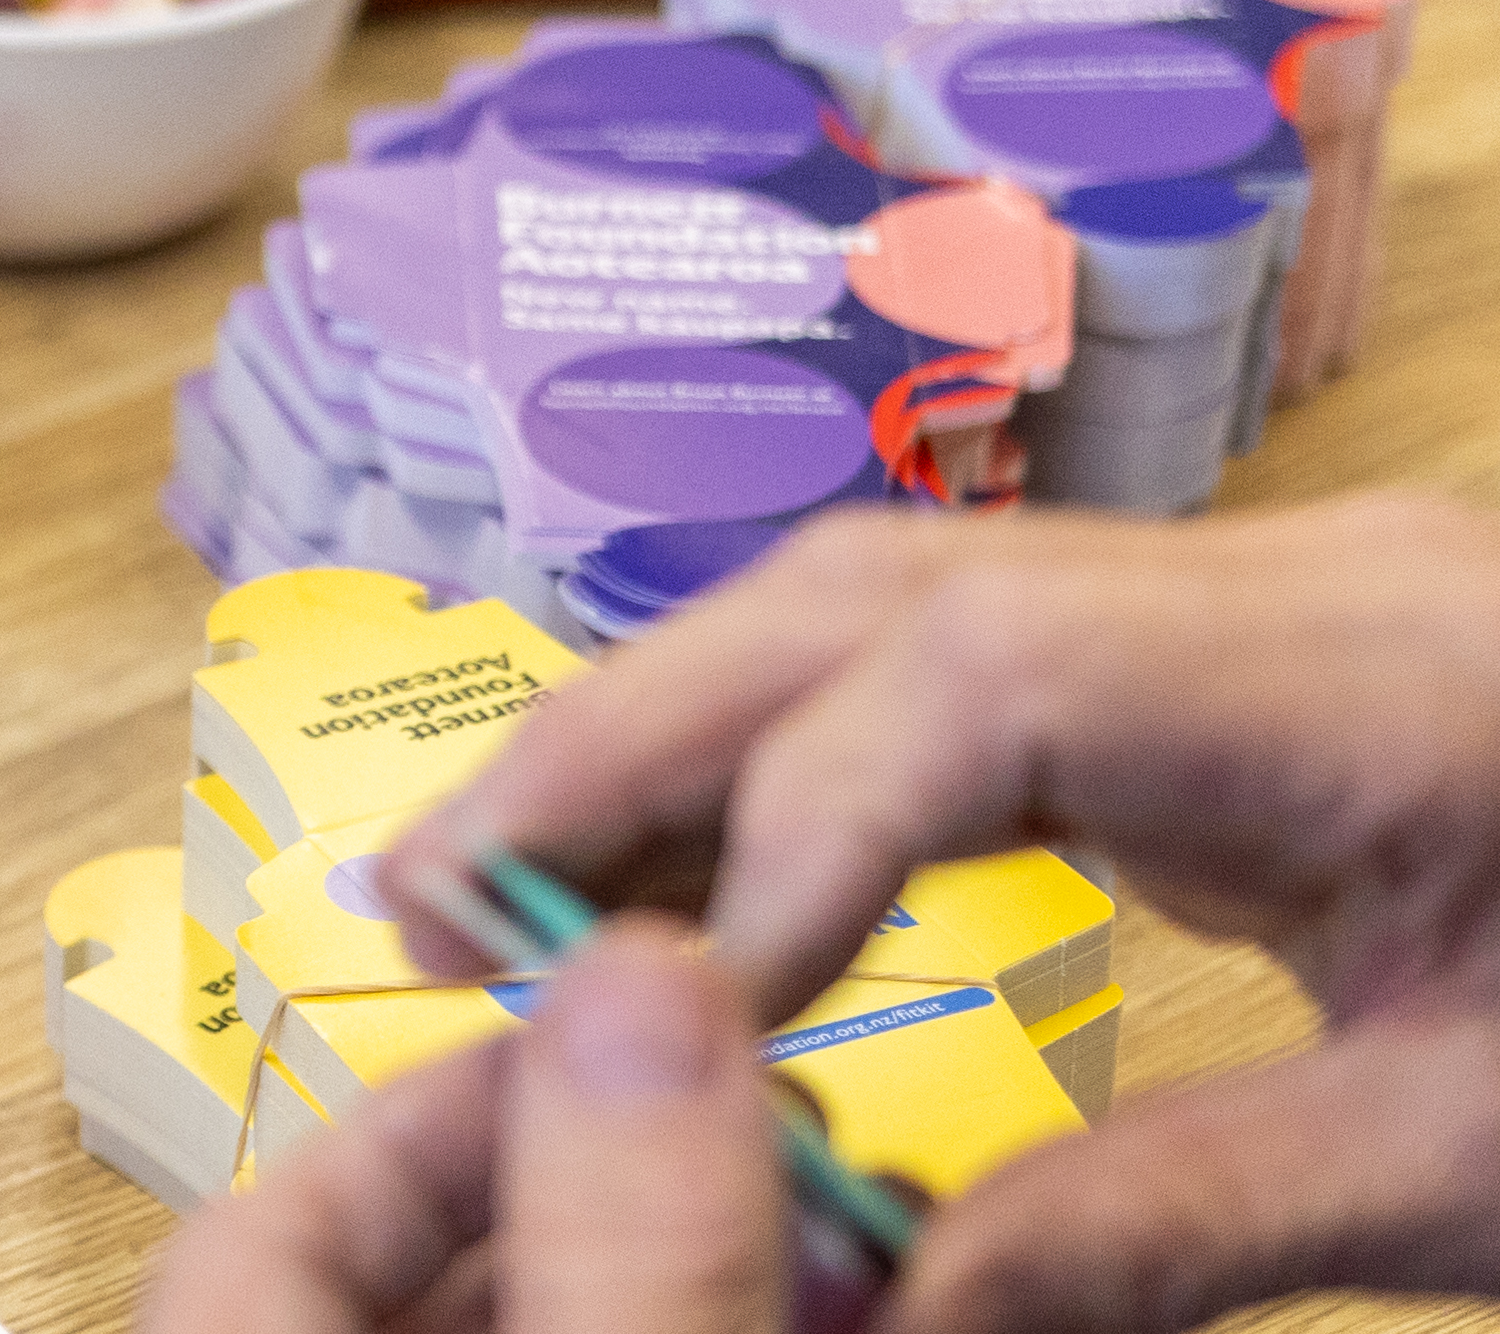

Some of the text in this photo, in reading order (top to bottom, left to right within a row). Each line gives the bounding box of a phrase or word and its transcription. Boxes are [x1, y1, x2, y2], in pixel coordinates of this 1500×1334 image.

[499, 182, 744, 224] Burnett
[499, 217, 880, 256] Foundation
[502, 247, 808, 284] Aotearoa
[501, 305, 626, 334] Same
[320, 650, 514, 708] Aotearoa
[300, 670, 544, 744] Foundation
